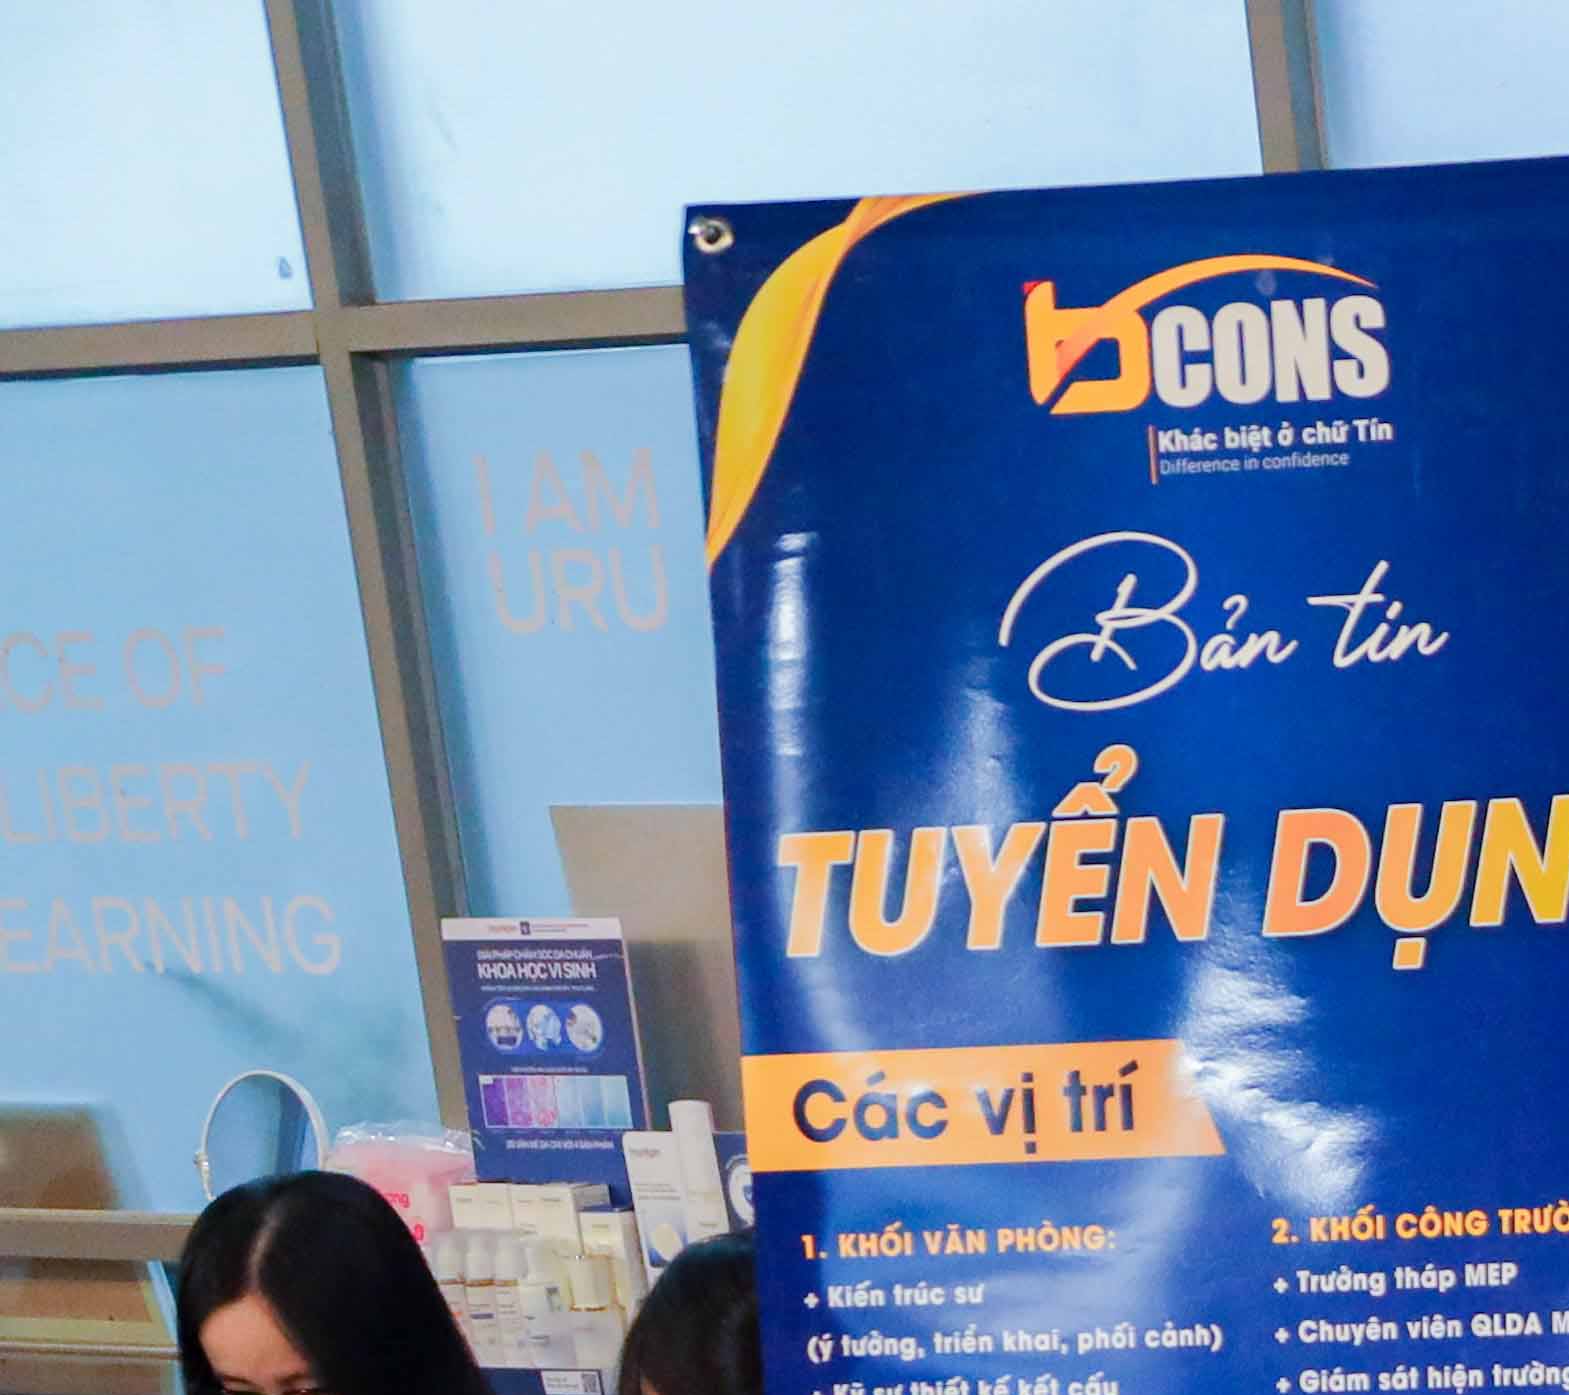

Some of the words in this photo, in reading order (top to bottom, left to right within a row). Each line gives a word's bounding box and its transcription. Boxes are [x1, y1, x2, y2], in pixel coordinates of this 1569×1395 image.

[1157, 429, 1217, 453] Khác
[1224, 424, 1272, 453] biệt
[1277, 425, 1293, 447] ở
[1301, 421, 1349, 444] chữ
[1353, 417, 1393, 442] Tín
[1160, 457, 1240, 475] Difference
[1244, 457, 1259, 470] in
[1263, 452, 1349, 470] confidence
[472, 452, 496, 538] I
[524, 446, 661, 536] AM
[999, 529, 1296, 712] Bản
[1306, 560, 1449, 669] tin
[123, 625, 226, 711] OF
[2, 760, 312, 843] LIBERTY
[776, 743, 1227, 959] TUYỂN
[791, 1071, 950, 1144] Các
[974, 1072, 1038, 1156] vị
[1062, 1062, 1137, 1134] trí
[801, 1234, 827, 1259] 1.
[839, 1221, 913, 1258] KHỐI
[922, 1223, 987, 1255] VĂN
[997, 1220, 1117, 1253] PHÒNG:
[1271, 1218, 1298, 1245] 2.
[1309, 1204, 1386, 1243] KHỐI
[1395, 1205, 1489, 1238] CÔNG
[1298, 1316, 1399, 1348] Chuyên
[1406, 1314, 1463, 1339] viên
[1471, 1312, 1543, 1339] QLDA
